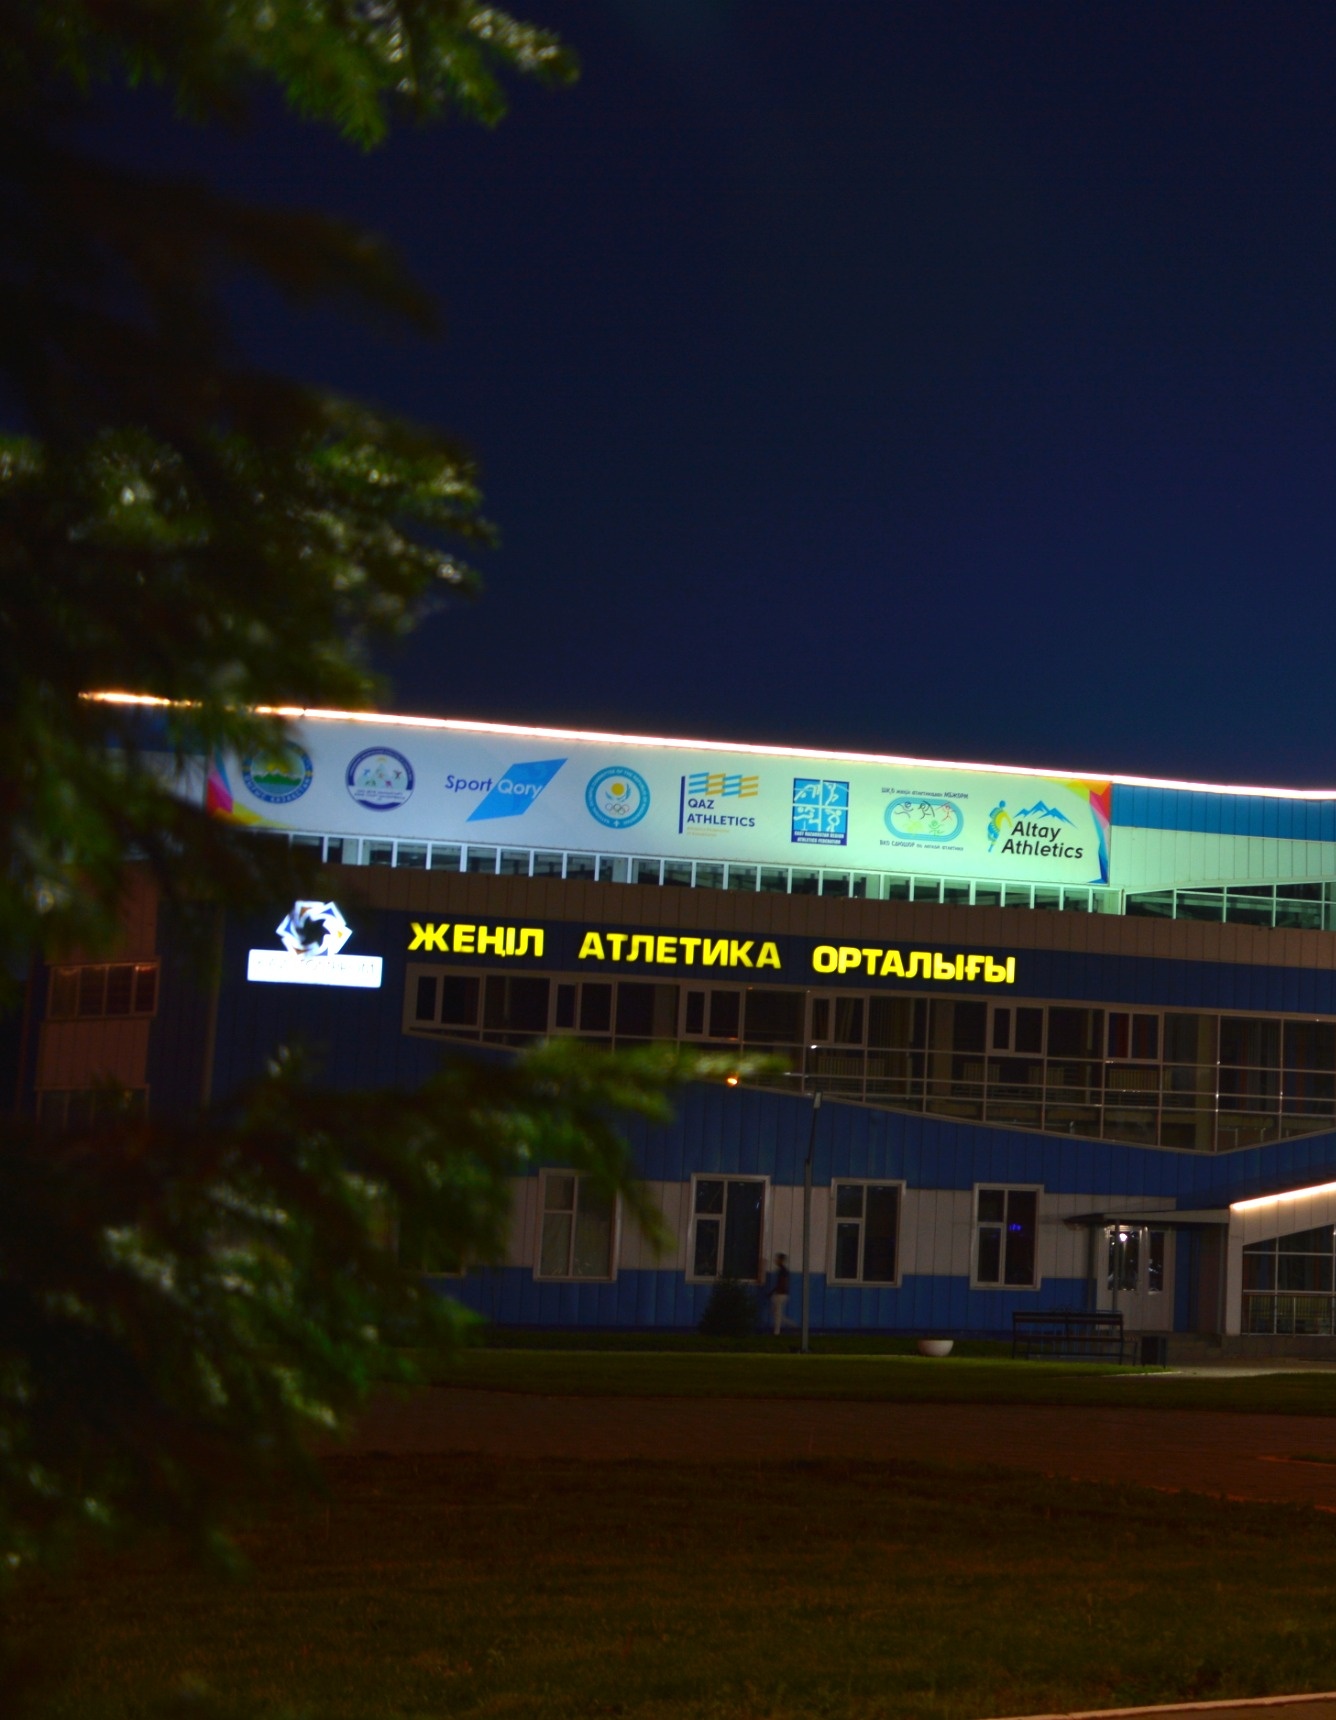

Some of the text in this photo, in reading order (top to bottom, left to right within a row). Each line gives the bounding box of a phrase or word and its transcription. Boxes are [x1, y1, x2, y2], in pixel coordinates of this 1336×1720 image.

[445, 774, 542, 799] Sport Qory
[687, 798, 715, 809] QAZ
[687, 813, 756, 828] ATHLETICS
[1011, 820, 1062, 842] Altay
[1001, 838, 1084, 859] Athletics
[407, 922, 1016, 984] ЖЕҢІЛ АТЛЕТИКА ОРТАЛЫҒЫ
